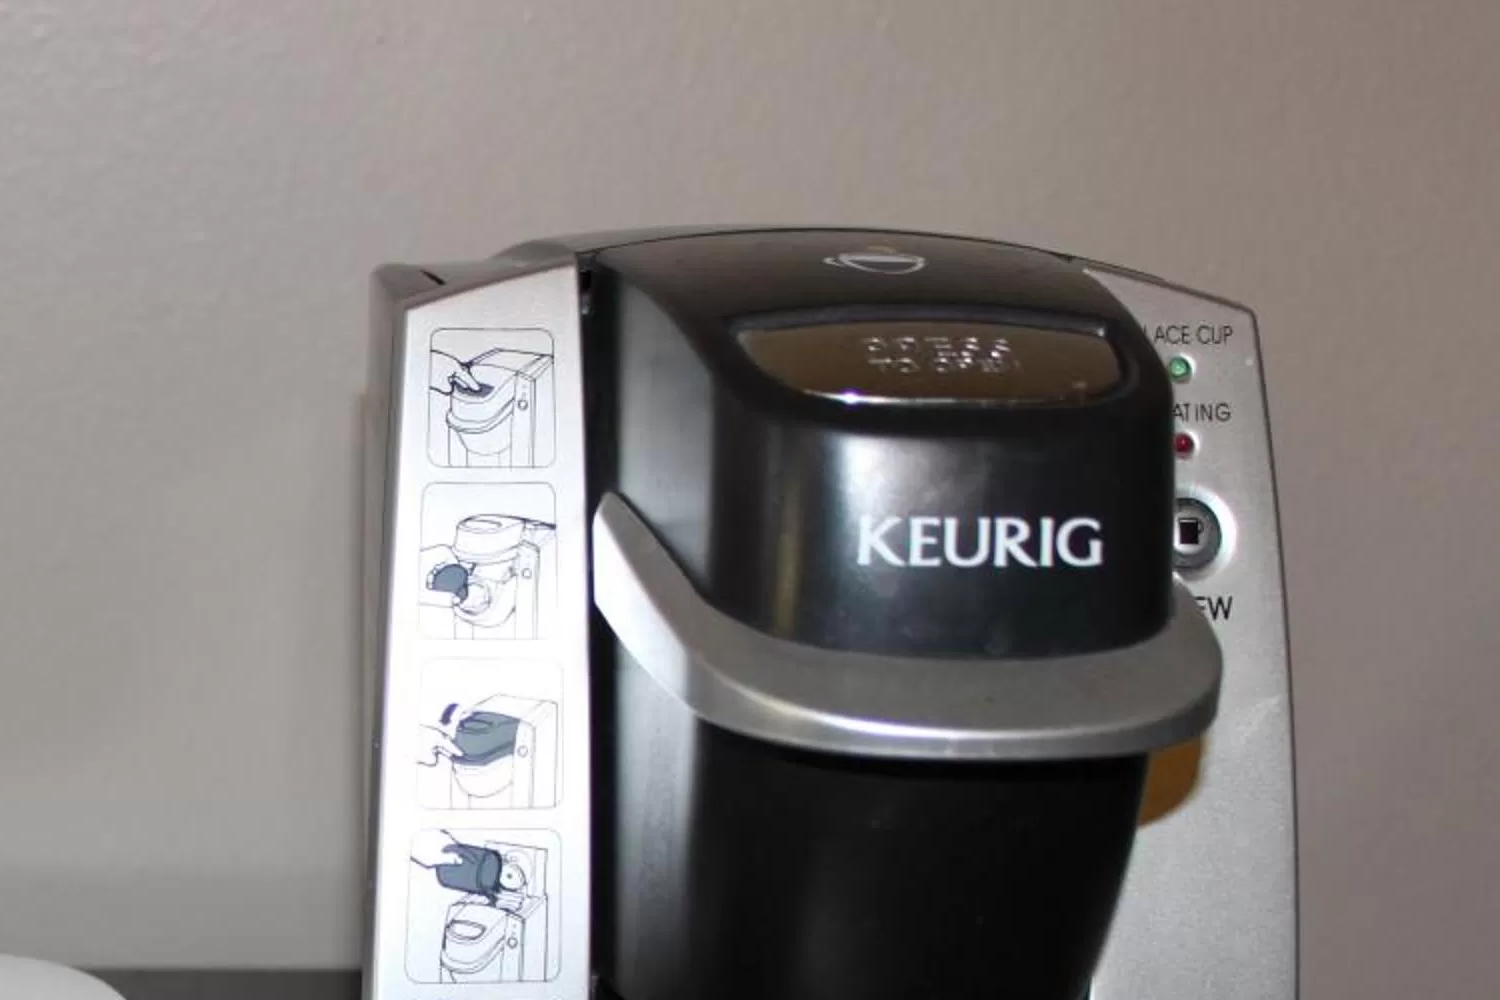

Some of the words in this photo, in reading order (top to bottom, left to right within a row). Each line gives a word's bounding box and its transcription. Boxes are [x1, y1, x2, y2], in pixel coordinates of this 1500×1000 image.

[1197, 324, 1233, 345] CUP
[1171, 403, 1232, 423] ATING
[856, 515, 1104, 569] KEURIG
